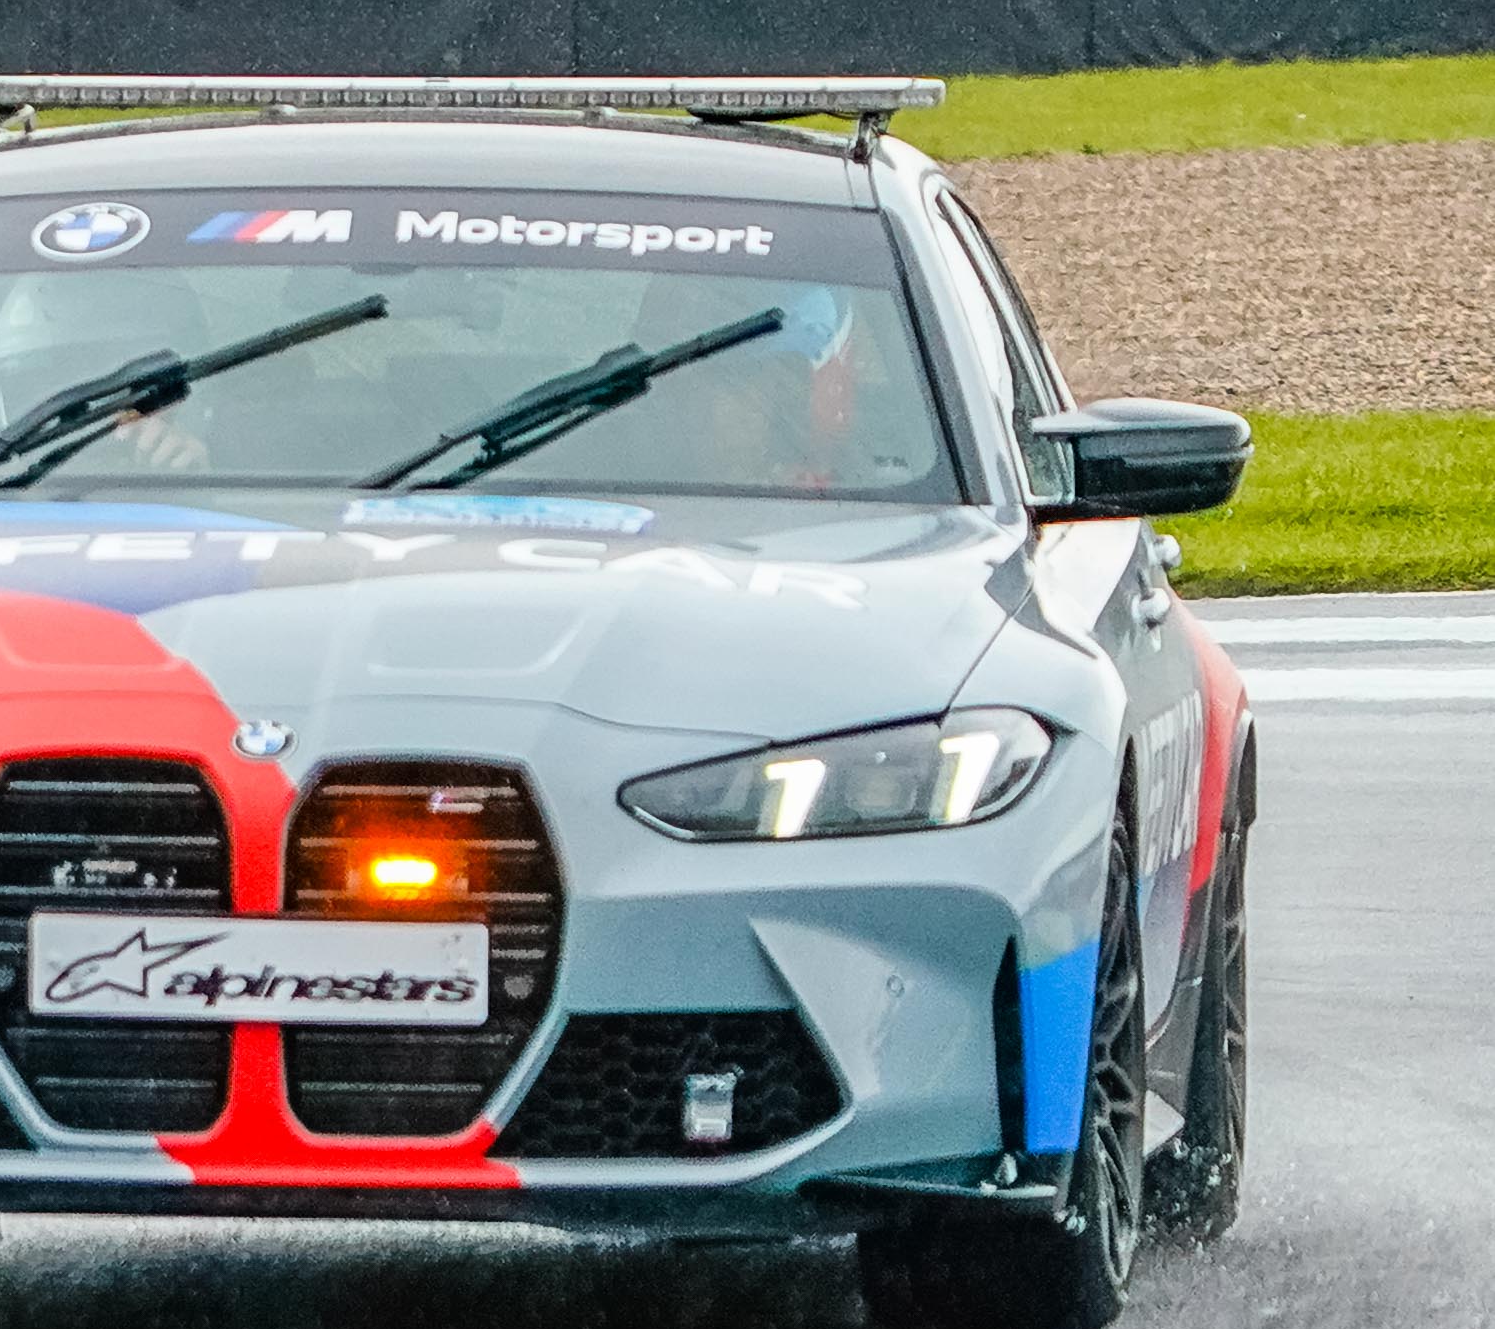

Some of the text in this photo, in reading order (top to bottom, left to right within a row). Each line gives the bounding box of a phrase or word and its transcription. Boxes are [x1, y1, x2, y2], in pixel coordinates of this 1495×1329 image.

[395, 210, 774, 257] Motorsport
[497, 538, 871, 611] CAR
[164, 963, 480, 1006] alpinestars
